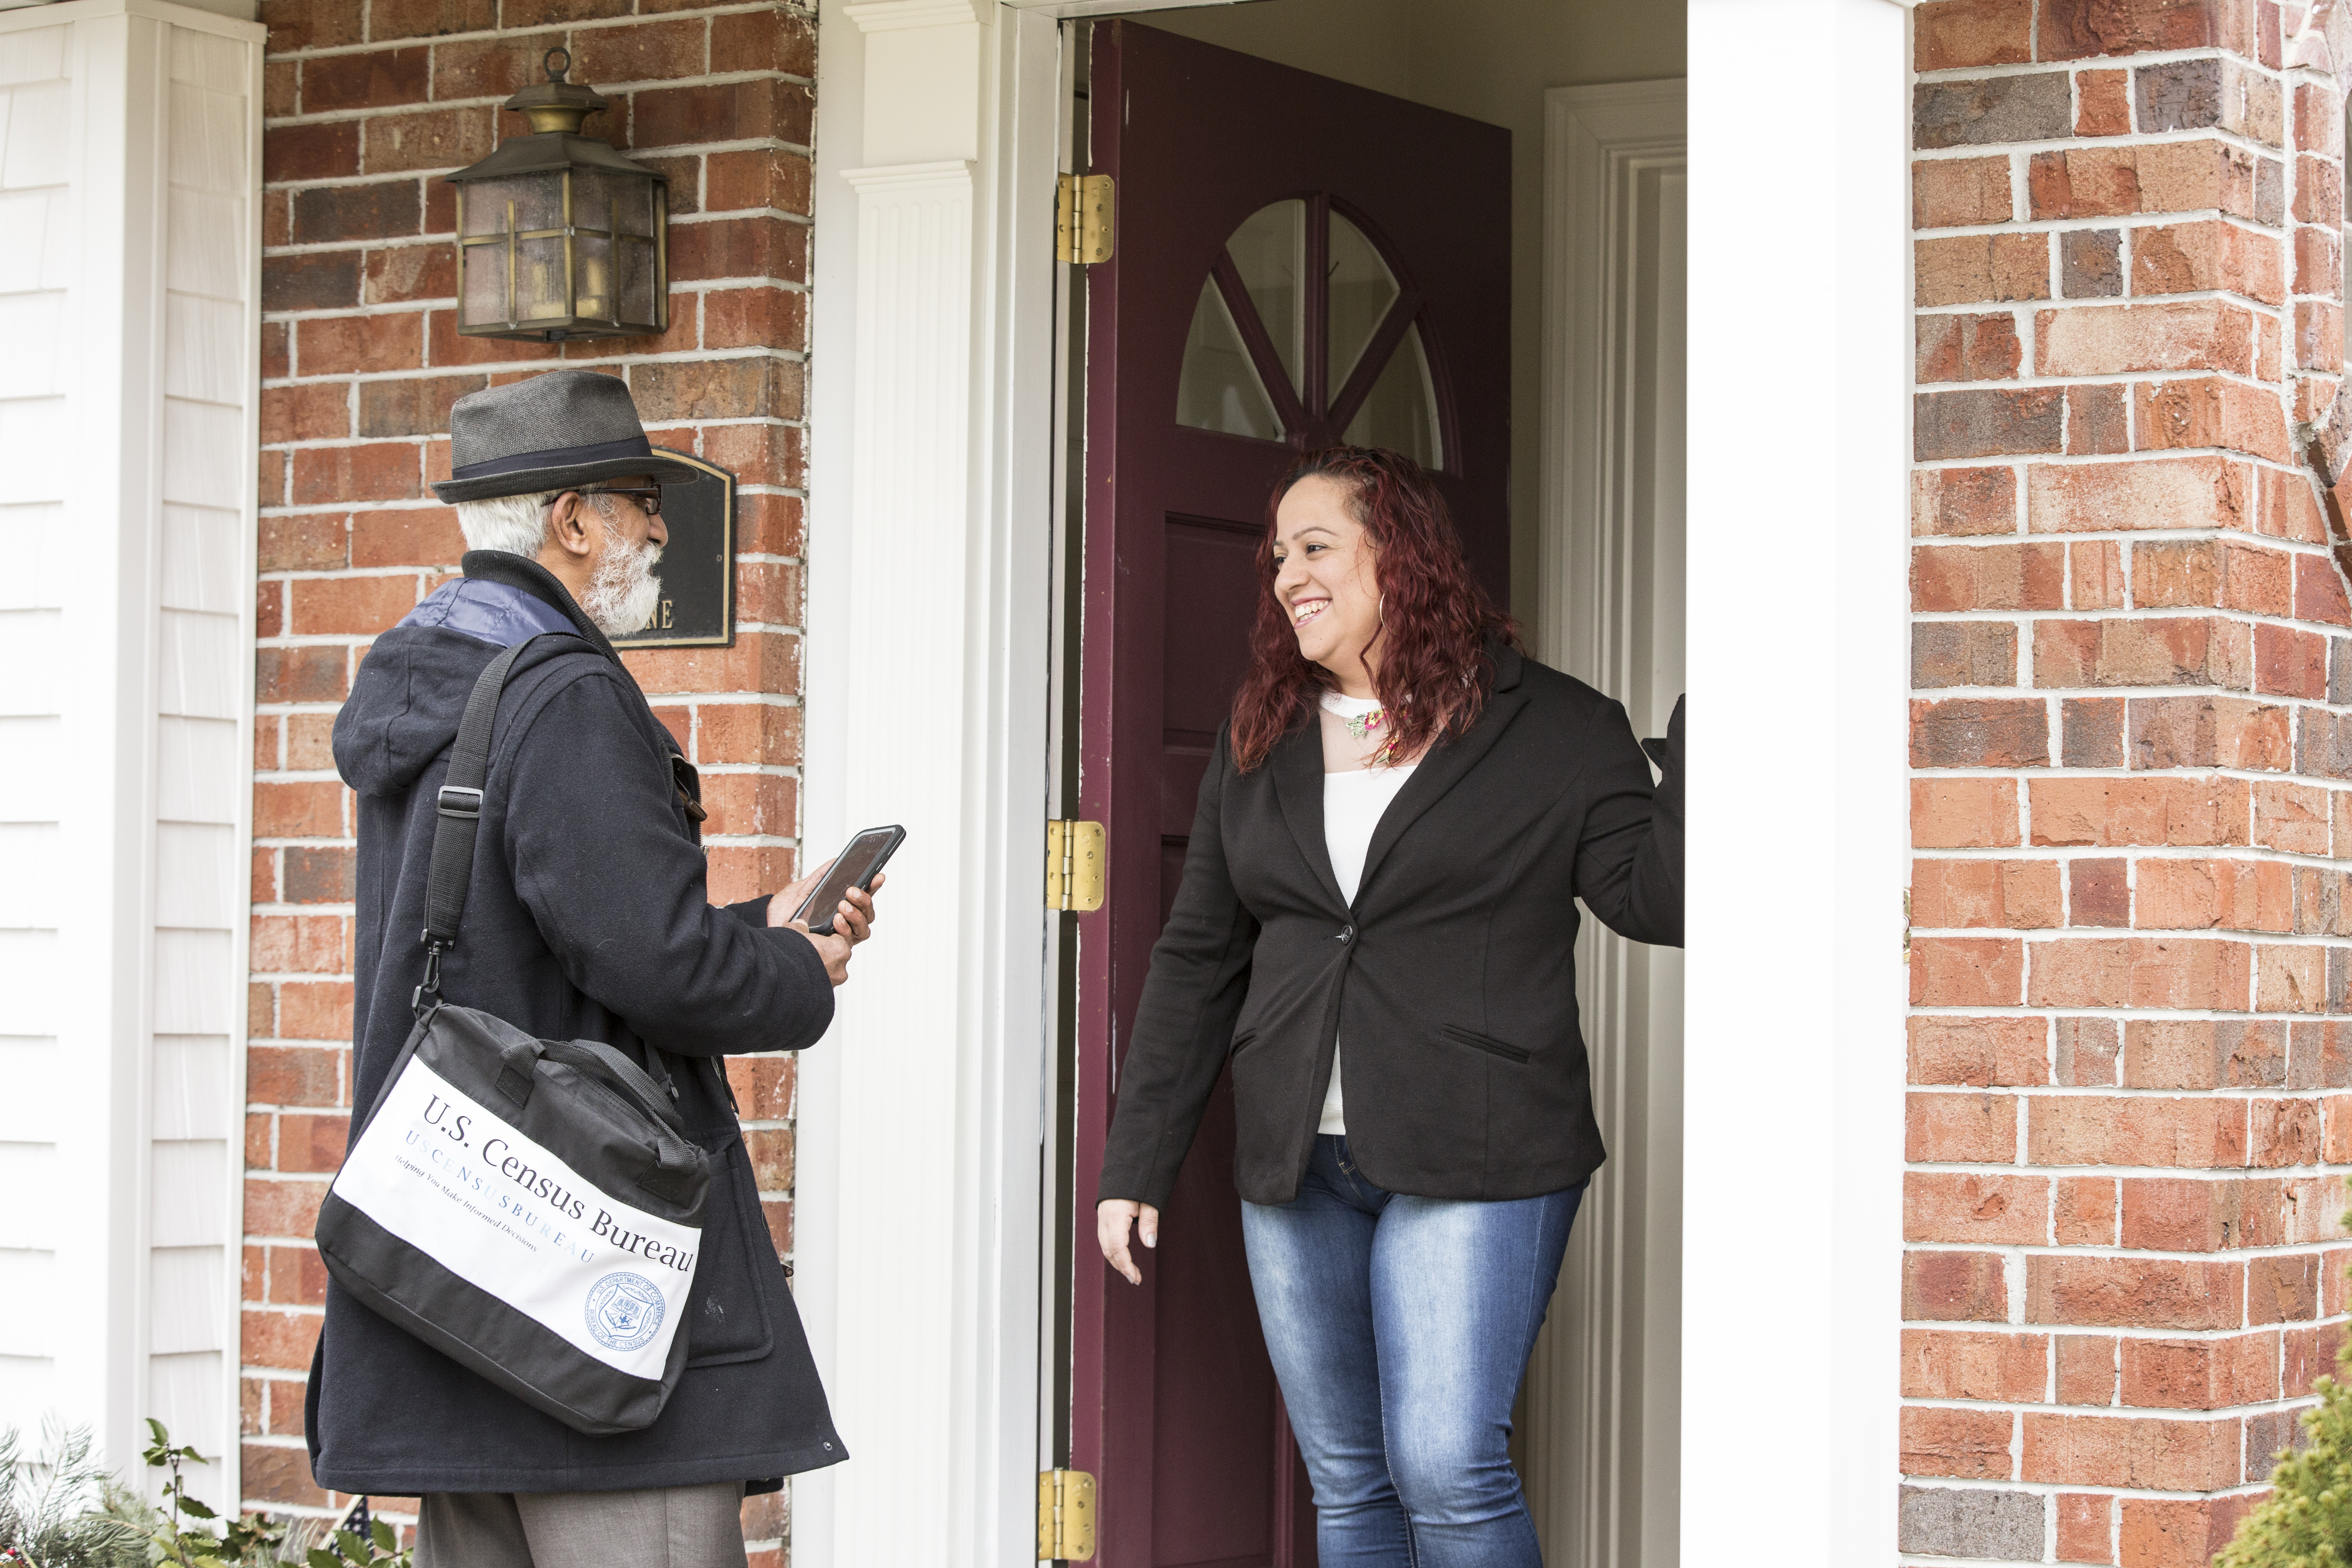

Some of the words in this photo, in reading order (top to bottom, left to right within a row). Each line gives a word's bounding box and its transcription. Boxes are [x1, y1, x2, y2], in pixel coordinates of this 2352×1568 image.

[395, 1155, 425, 1177] Helping
[427, 1174, 440, 1188] You
[441, 1186, 462, 1203] Make
[463, 1200, 501, 1227] Informed
[501, 1224, 538, 1252] Decisions
[424, 1094, 472, 1148] U.S.
[483, 1139, 585, 1219] Census
[589, 1208, 693, 1272] Bureau
[589, 1309, 599, 1332] BUREAU
[606, 1337, 618, 1346] THE
[619, 1337, 644, 1347] CENSUS
[597, 1284, 606, 1294] U.S.
[606, 1277, 644, 1287] DEPARTMENT
[650, 1292, 661, 1325] COMMERCE
